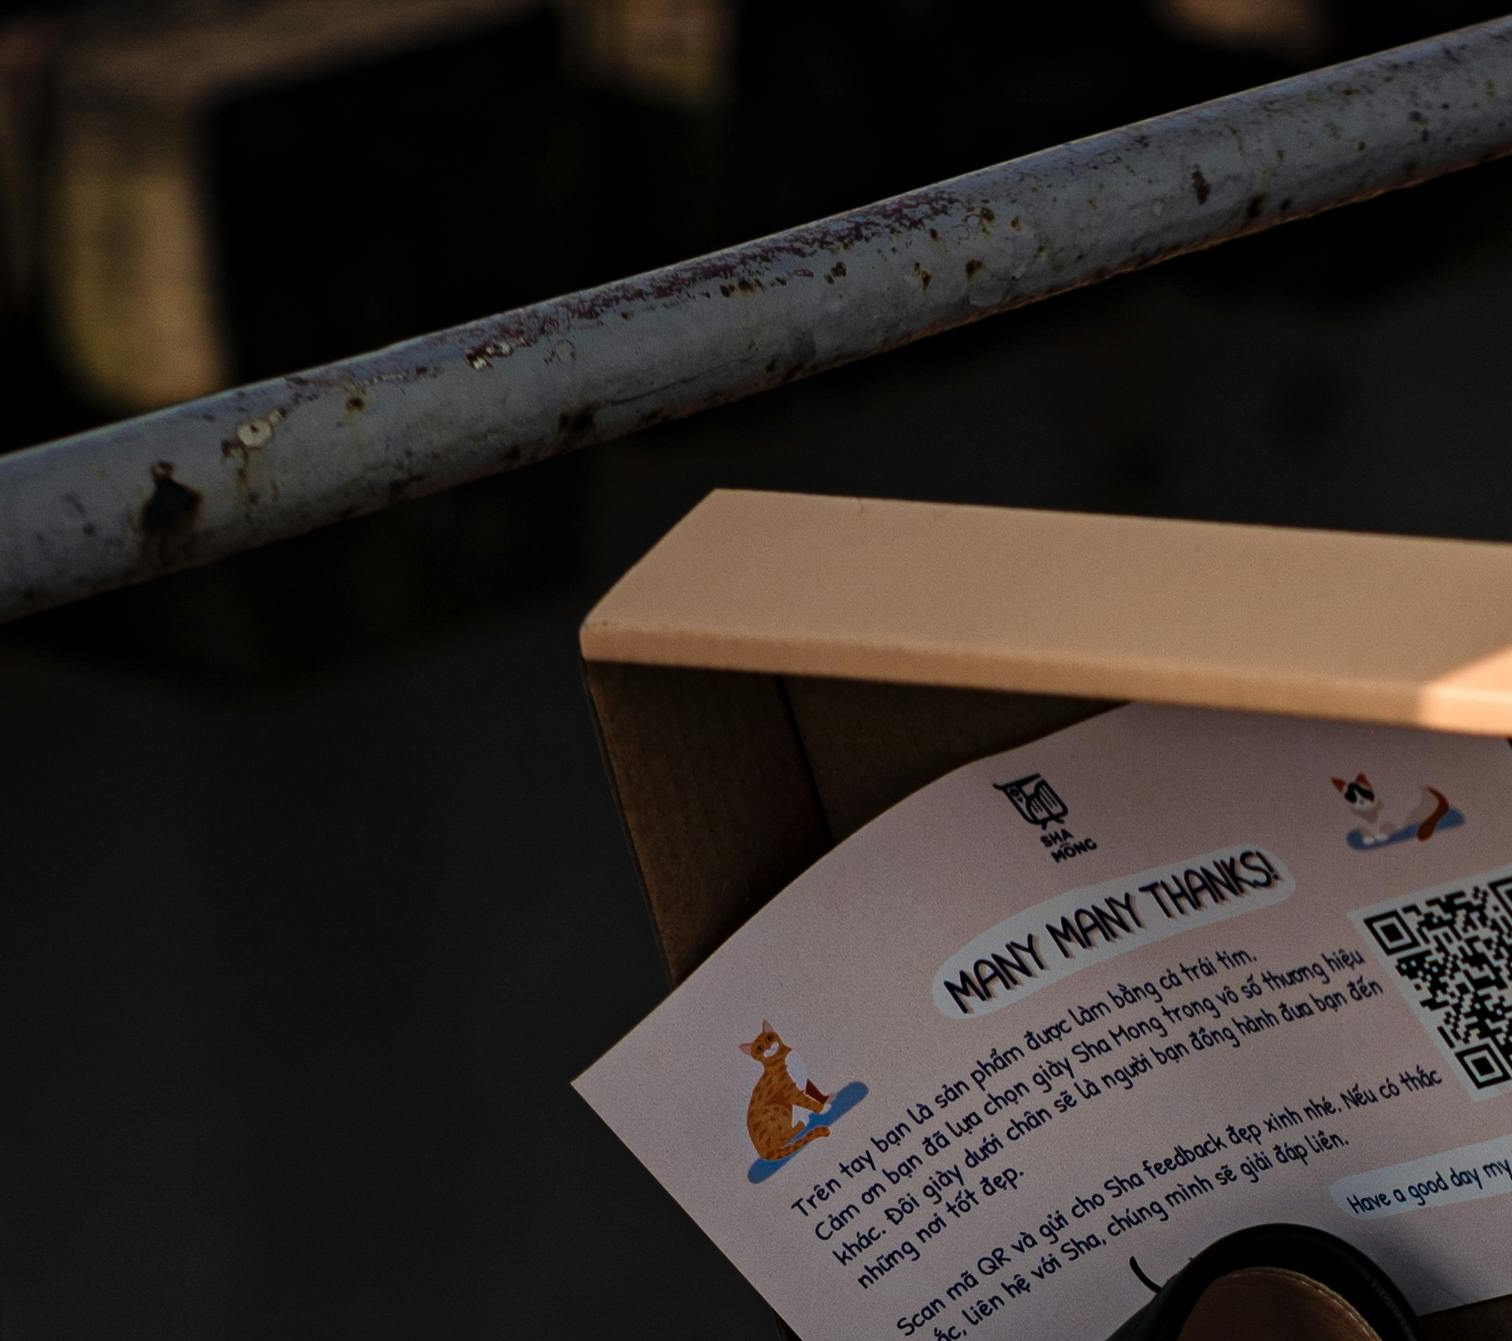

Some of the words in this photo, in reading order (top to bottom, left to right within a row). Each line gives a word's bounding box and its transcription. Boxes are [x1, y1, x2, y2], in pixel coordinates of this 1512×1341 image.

[1040, 828, 1074, 848] SHA
[944, 934, 1046, 1014] MANY
[1045, 892, 1145, 958] MANY
[1139, 850, 1281, 918] THANKS!
[791, 1179, 841, 1216] Trên
[839, 1150, 876, 1178] tay
[870, 1123, 911, 1153] bạn
[907, 1104, 934, 1124] là
[935, 1081, 970, 1108] sản
[970, 1047, 1025, 1091] phẩm
[1024, 1020, 1072, 1050] được
[1068, 1002, 1111, 1026] làm
[1160, 969, 1182, 990] cả
[1179, 957, 1217, 981] trái
[1216, 950, 1257, 969] tim.
[815, 1204, 860, 1240] Cảm
[861, 1183, 886, 1204] ơn
[882, 1155, 923, 1184] bạn
[922, 1131, 950, 1156] đã
[945, 1112, 983, 1137] lựa
[984, 1082, 1030, 1115] chọn
[1033, 1057, 1074, 1093] giày
[1071, 1039, 1112, 1063] Sha
[1108, 1017, 1168, 1046] Mong
[1161, 998, 1221, 1023] trong
[1216, 986, 1239, 1005] vô
[1241, 974, 1262, 999] số
[1261, 963, 1330, 990] thương
[1321, 949, 1365, 972] hiệu
[833, 1227, 886, 1266] khác.
[884, 1193, 920, 1225] Đôi
[923, 1165, 964, 1205] giày
[965, 1133, 1004, 1168] dưới
[1006, 1108, 1052, 1141] chân
[1054, 1090, 1077, 1113] sẽ
[1074, 1079, 1101, 1099] là
[1101, 1053, 1153, 1090] người
[1150, 1043, 1189, 1065] bạn
[1232, 1009, 1279, 1035] hành
[1279, 1002, 1314, 1022] đưa
[1309, 992, 1347, 1012] bạn
[1347, 976, 1383, 1001] đến
[858, 1241, 920, 1289] những
[916, 1213, 947, 1243] nơi
[946, 1189, 979, 1218] tốt
[980, 1168, 1023, 1196] đẹp.
[897, 1299, 946, 1336] Scan
[946, 1271, 979, 1300] mã
[978, 1248, 1011, 1275] QR
[1011, 1232, 1038, 1253] và
[1039, 1210, 1068, 1244] gửi
[1072, 1194, 1105, 1218] cho
[1104, 1173, 1144, 1198] Sha
[1142, 1133, 1227, 1179] feedback
[1226, 1124, 1261, 1145] đẹp
[1263, 1107, 1303, 1132] xinh
[1303, 1096, 1342, 1120] nhé.
[1340, 1084, 1378, 1109] Nếu
[1379, 1078, 1400, 1099] có
[962, 1296, 1005, 1325] liên
[1001, 1274, 1030, 1298] hệ
[1031, 1253, 1062, 1279] với
[1061, 1234, 1106, 1261] Sha,
[1107, 1201, 1169, 1236] chúng
[1165, 1175, 1214, 1207] mình
[1215, 1165, 1237, 1185] sẽ
[1240, 1151, 1273, 1183] giải
[1273, 1143, 1308, 1165] đáp
[1347, 1193, 1391, 1213] Have
[1393, 1189, 1406, 1202] a
[1408, 1172, 1449, 1206] good
[1450, 1168, 1482, 1189] day
[1482, 1160, 1512, 1180] my
